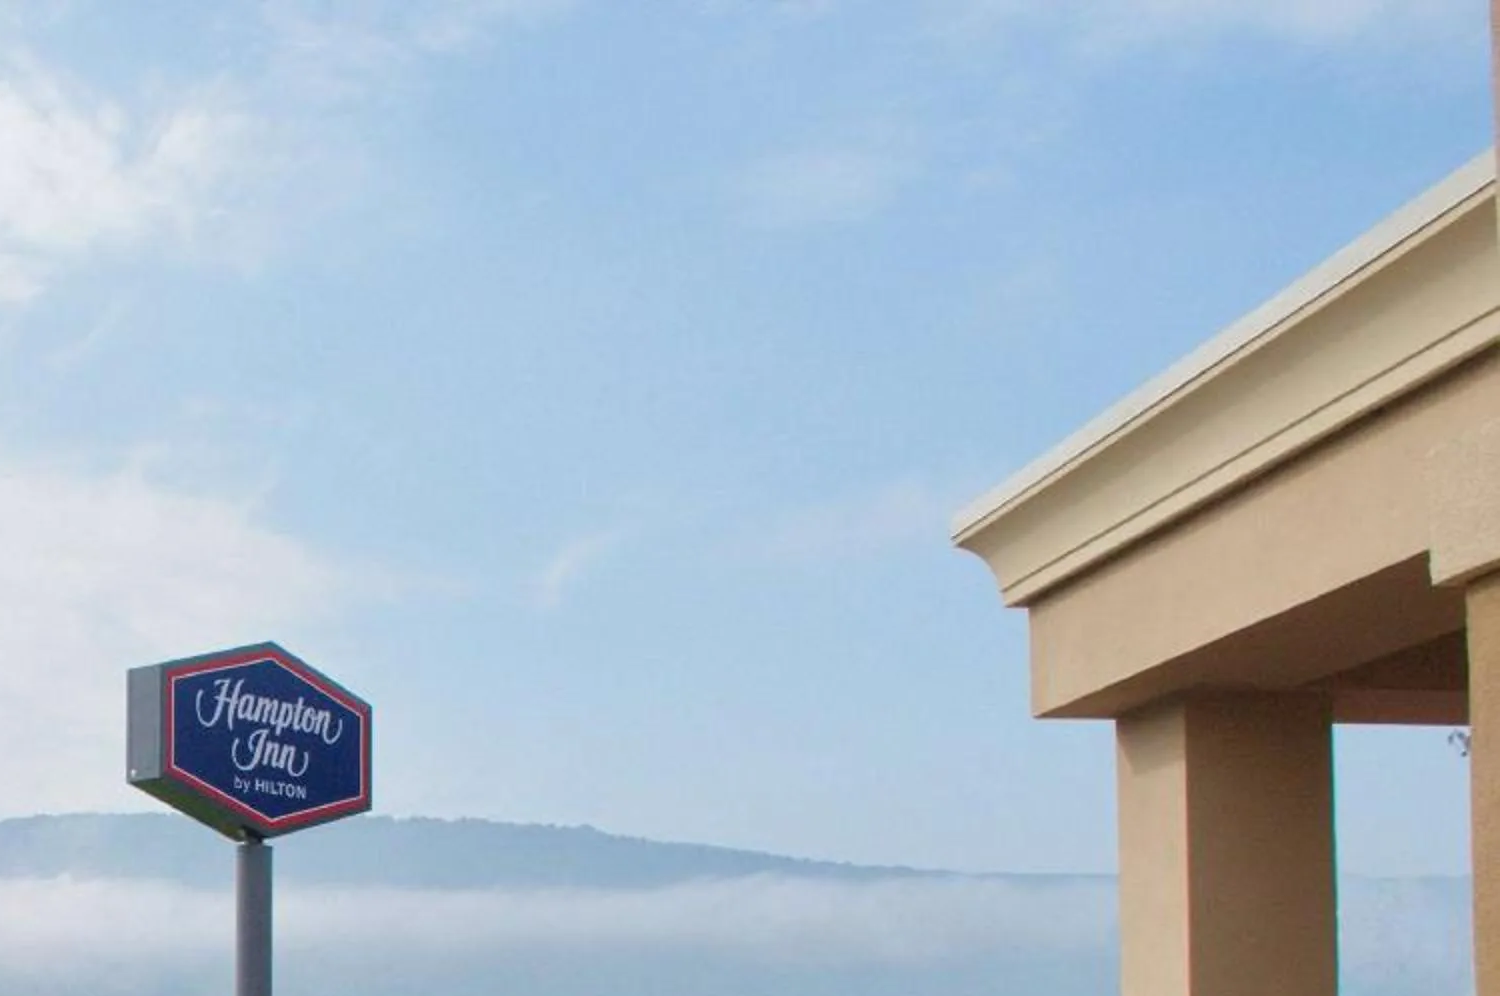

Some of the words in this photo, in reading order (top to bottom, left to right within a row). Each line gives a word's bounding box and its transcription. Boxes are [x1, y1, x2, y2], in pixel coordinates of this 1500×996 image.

[195, 678, 343, 744] Hampton
[231, 728, 309, 777] Inn
[233, 775, 251, 794] by
[255, 779, 307, 799] HILTON
